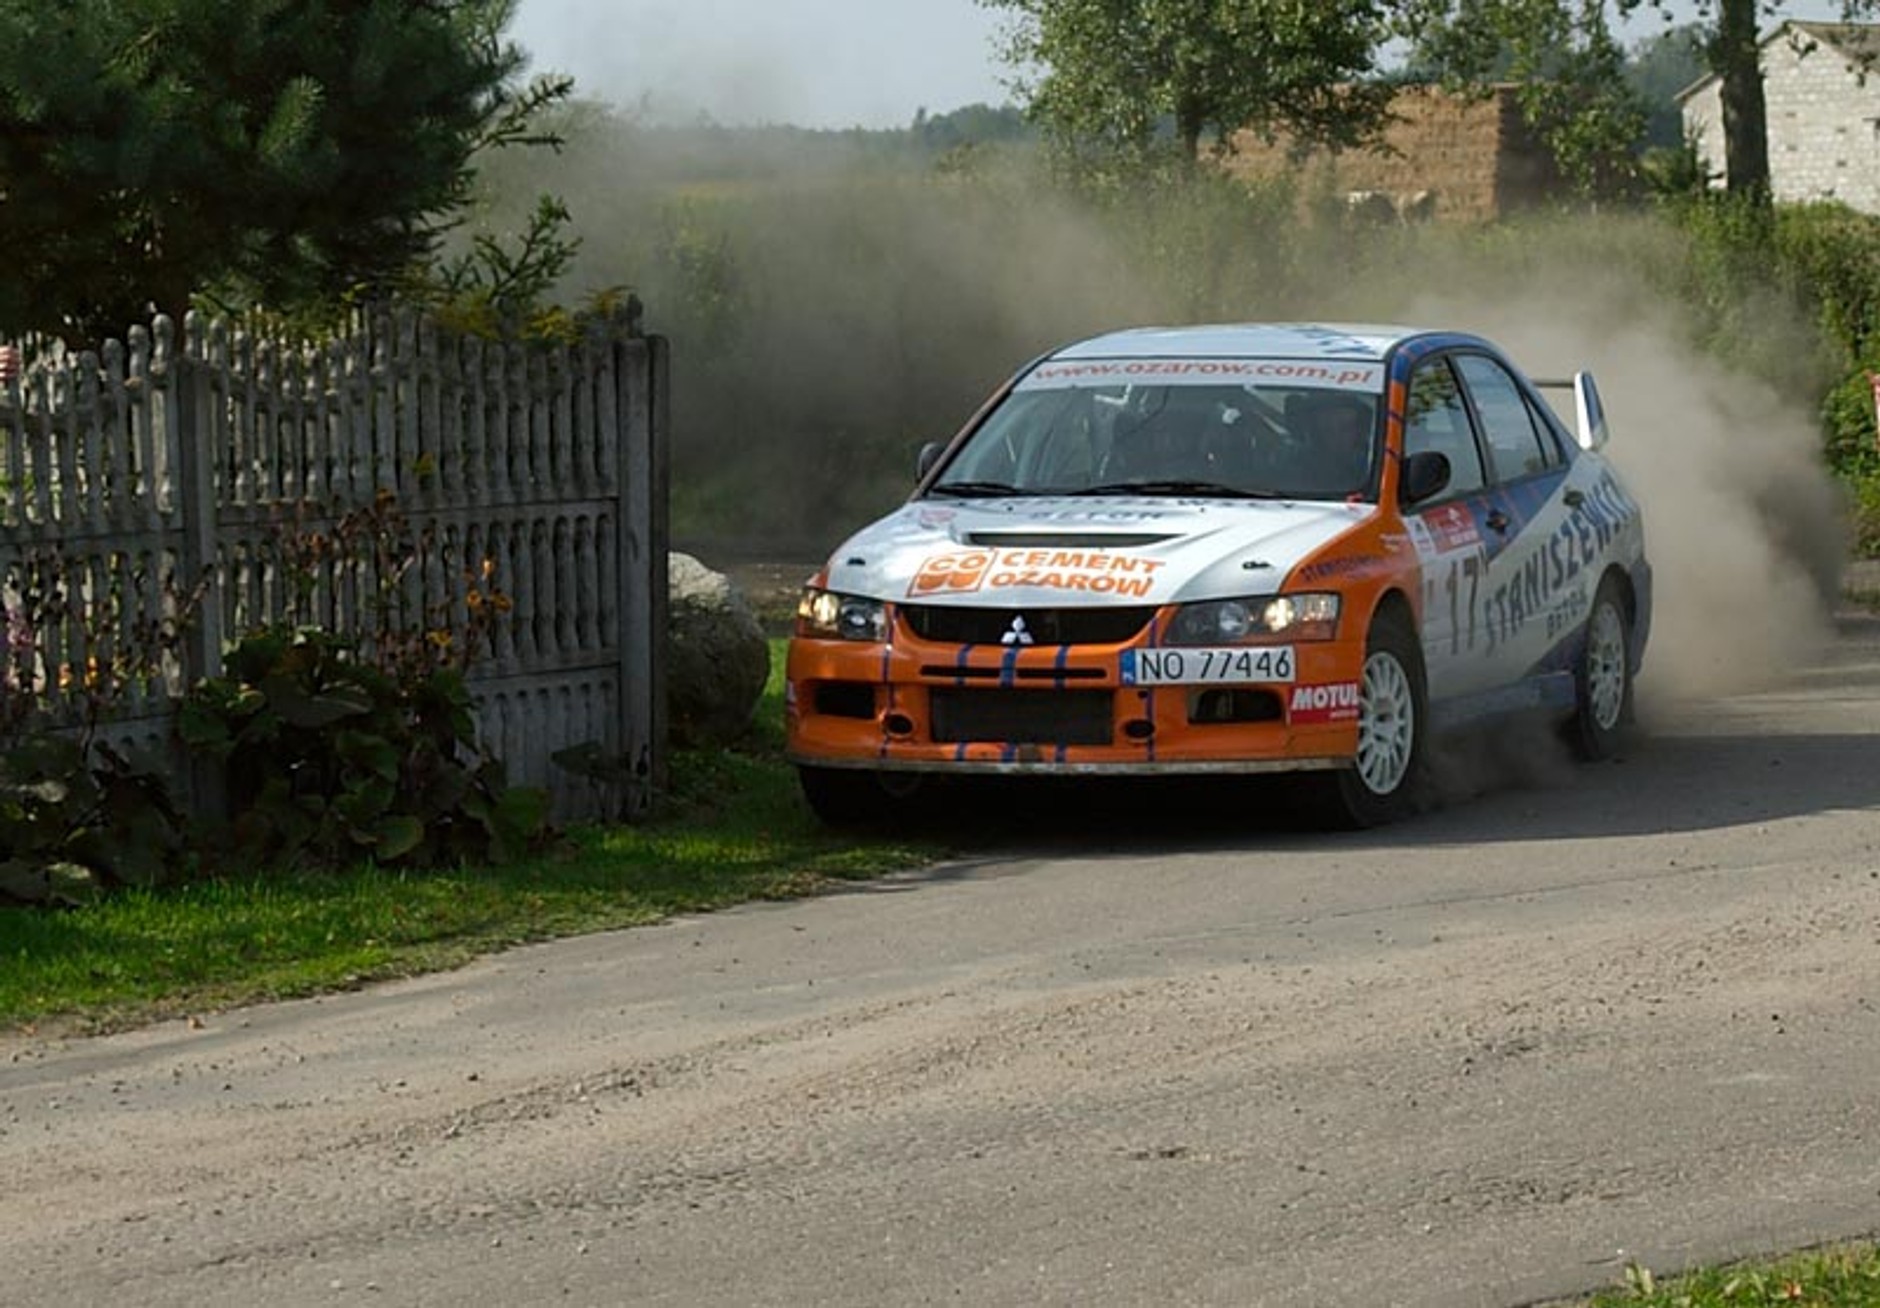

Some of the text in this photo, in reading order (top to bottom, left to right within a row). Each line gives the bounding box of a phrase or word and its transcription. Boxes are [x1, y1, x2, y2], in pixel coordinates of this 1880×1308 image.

[1035, 362, 1373, 384] www.ozarow.com.pl
[1002, 550, 1167, 574] CEMENT
[1142, 652, 1184, 680] NO
[1199, 649, 1290, 679] 77446
[1290, 683, 1359, 711] MOTUL
